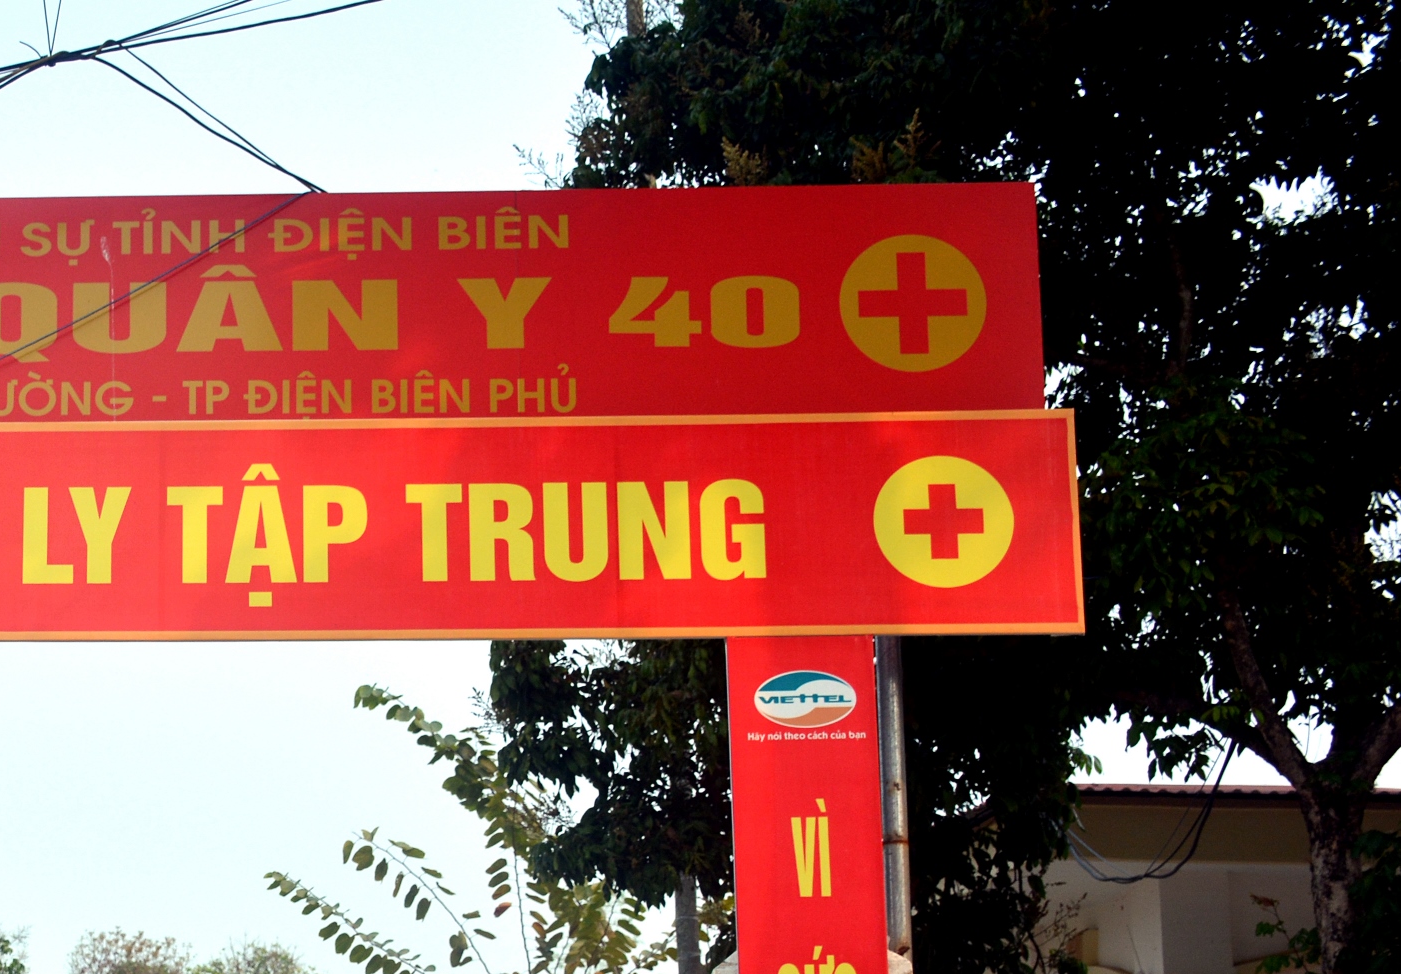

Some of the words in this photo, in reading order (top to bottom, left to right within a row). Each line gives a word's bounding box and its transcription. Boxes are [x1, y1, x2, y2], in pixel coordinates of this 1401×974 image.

[20, 218, 95, 267] SỰ
[112, 207, 247, 257] TỈNH
[267, 208, 412, 260] ĐIỆN
[437, 206, 571, 251] BIÊN
[457, 276, 552, 350] Y
[608, 274, 802, 349] 40
[182, 379, 231, 415] TP
[243, 370, 352, 421] ĐIỆN
[371, 369, 471, 415] BIÊN
[489, 363, 578, 414] PHỦ
[21, 486, 132, 584] LY
[166, 463, 369, 607] TẬP
[405, 478, 767, 582] TRUNG
[758, 693, 852, 704] VIETTEL
[767, 731, 782, 741] nói
[784, 731, 806, 741] theo
[807, 730, 828, 741] cách
[830, 729, 847, 740] của
[848, 730, 867, 742] bạn
[791, 798, 832, 898] VÌ
